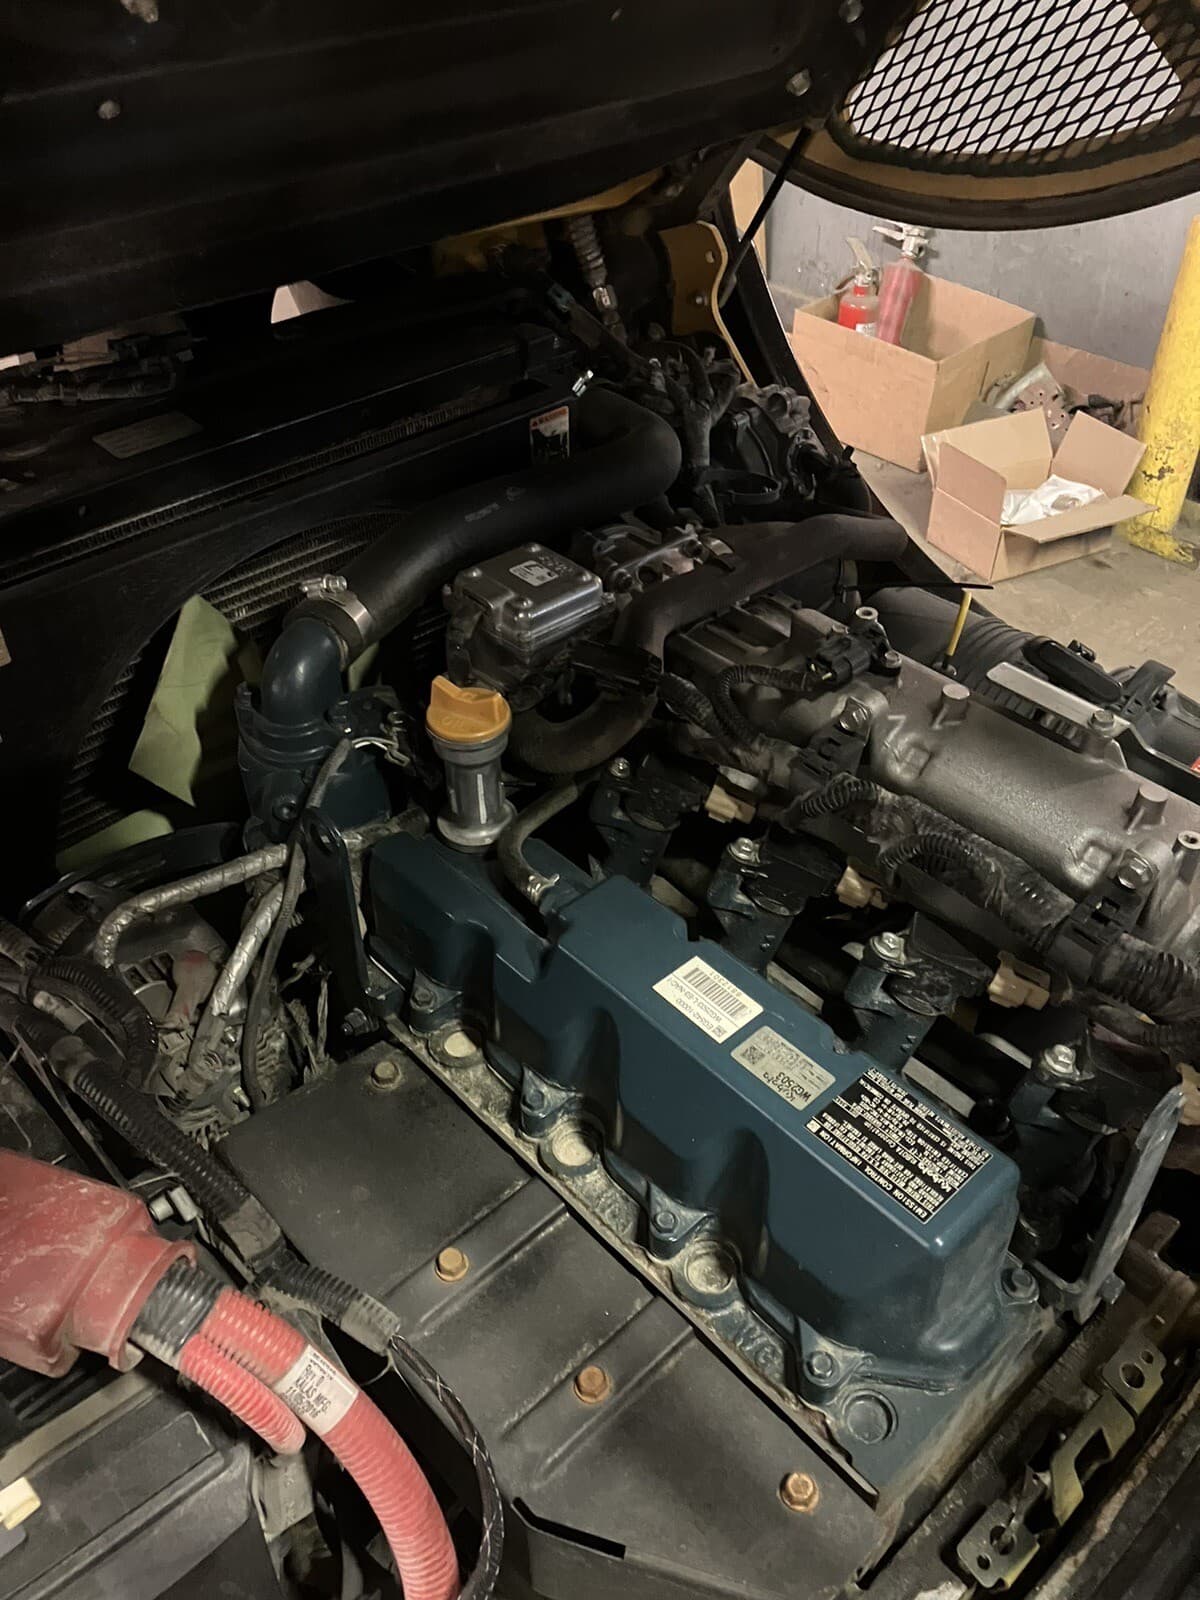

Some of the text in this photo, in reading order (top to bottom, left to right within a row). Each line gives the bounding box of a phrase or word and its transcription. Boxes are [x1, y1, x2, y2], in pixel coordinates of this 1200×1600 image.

[774, 1071, 812, 1101] WG2503
[860, 1120, 897, 1149] Corporation
[893, 1145, 918, 1166] KUBOTA
[818, 1129, 928, 1218] EMISSION CONTROL INFORMATION
[914, 1161, 953, 1193] Kubota
